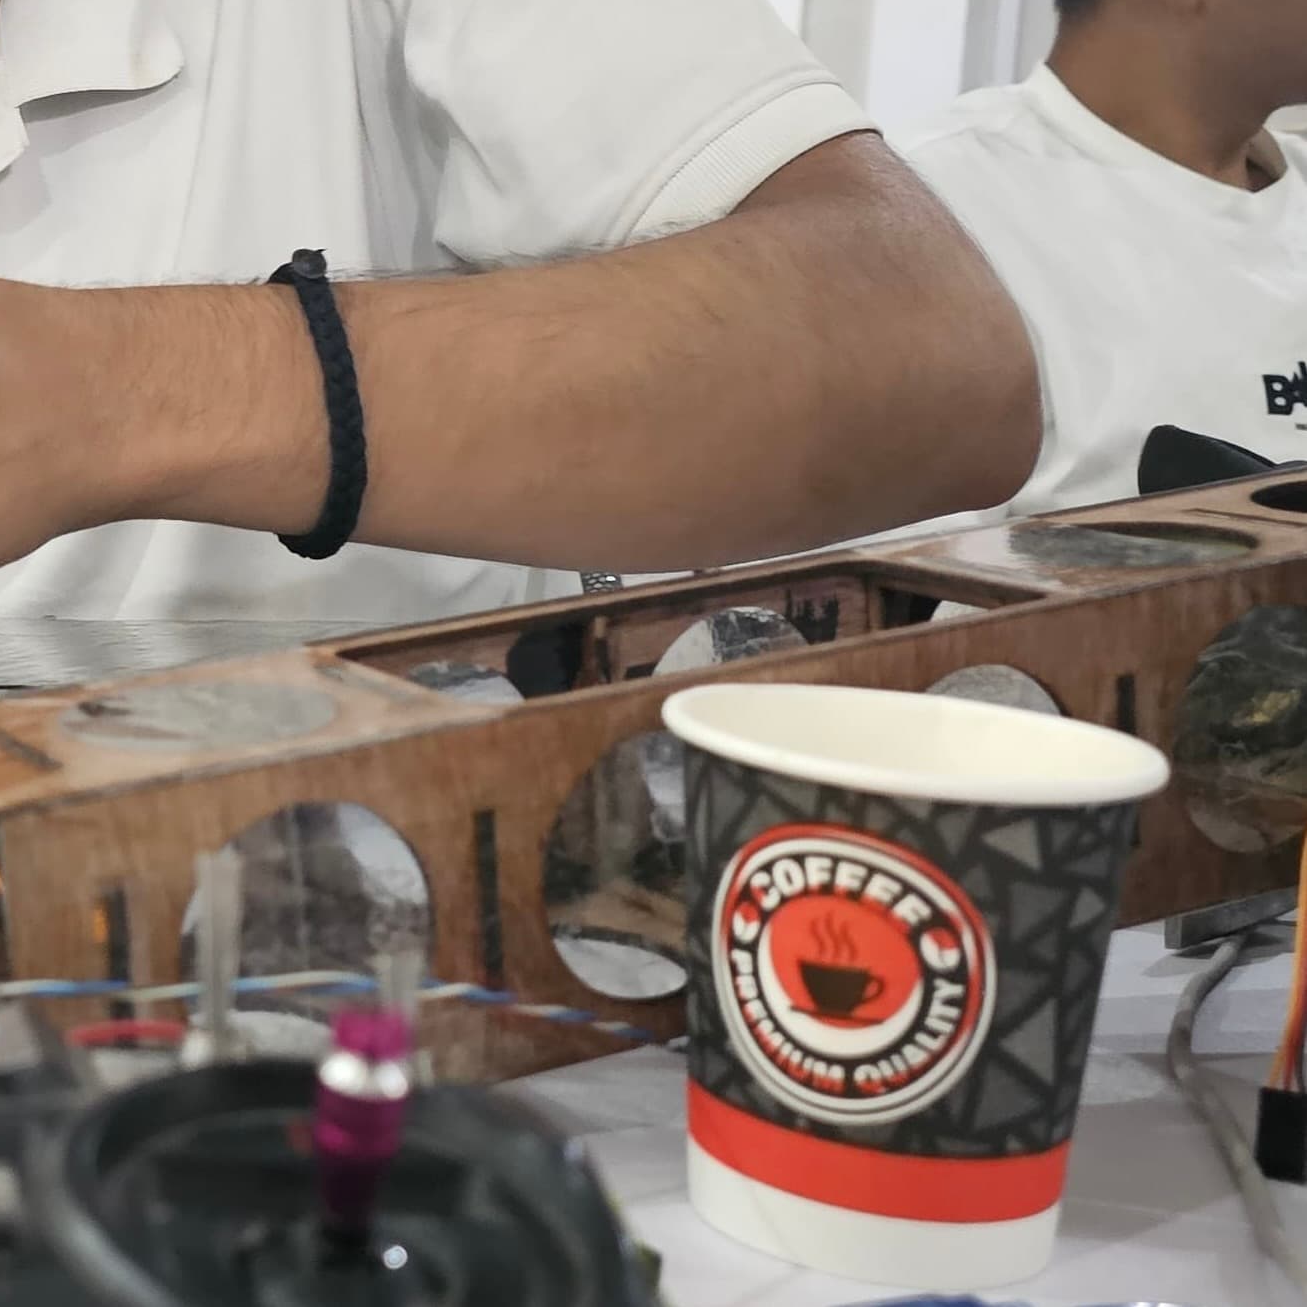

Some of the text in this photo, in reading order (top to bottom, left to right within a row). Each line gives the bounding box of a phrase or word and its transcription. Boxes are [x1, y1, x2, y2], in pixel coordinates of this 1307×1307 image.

[750, 856, 932, 931] COFFEE
[731, 949, 965, 1093] PREMIUM QUALITY
